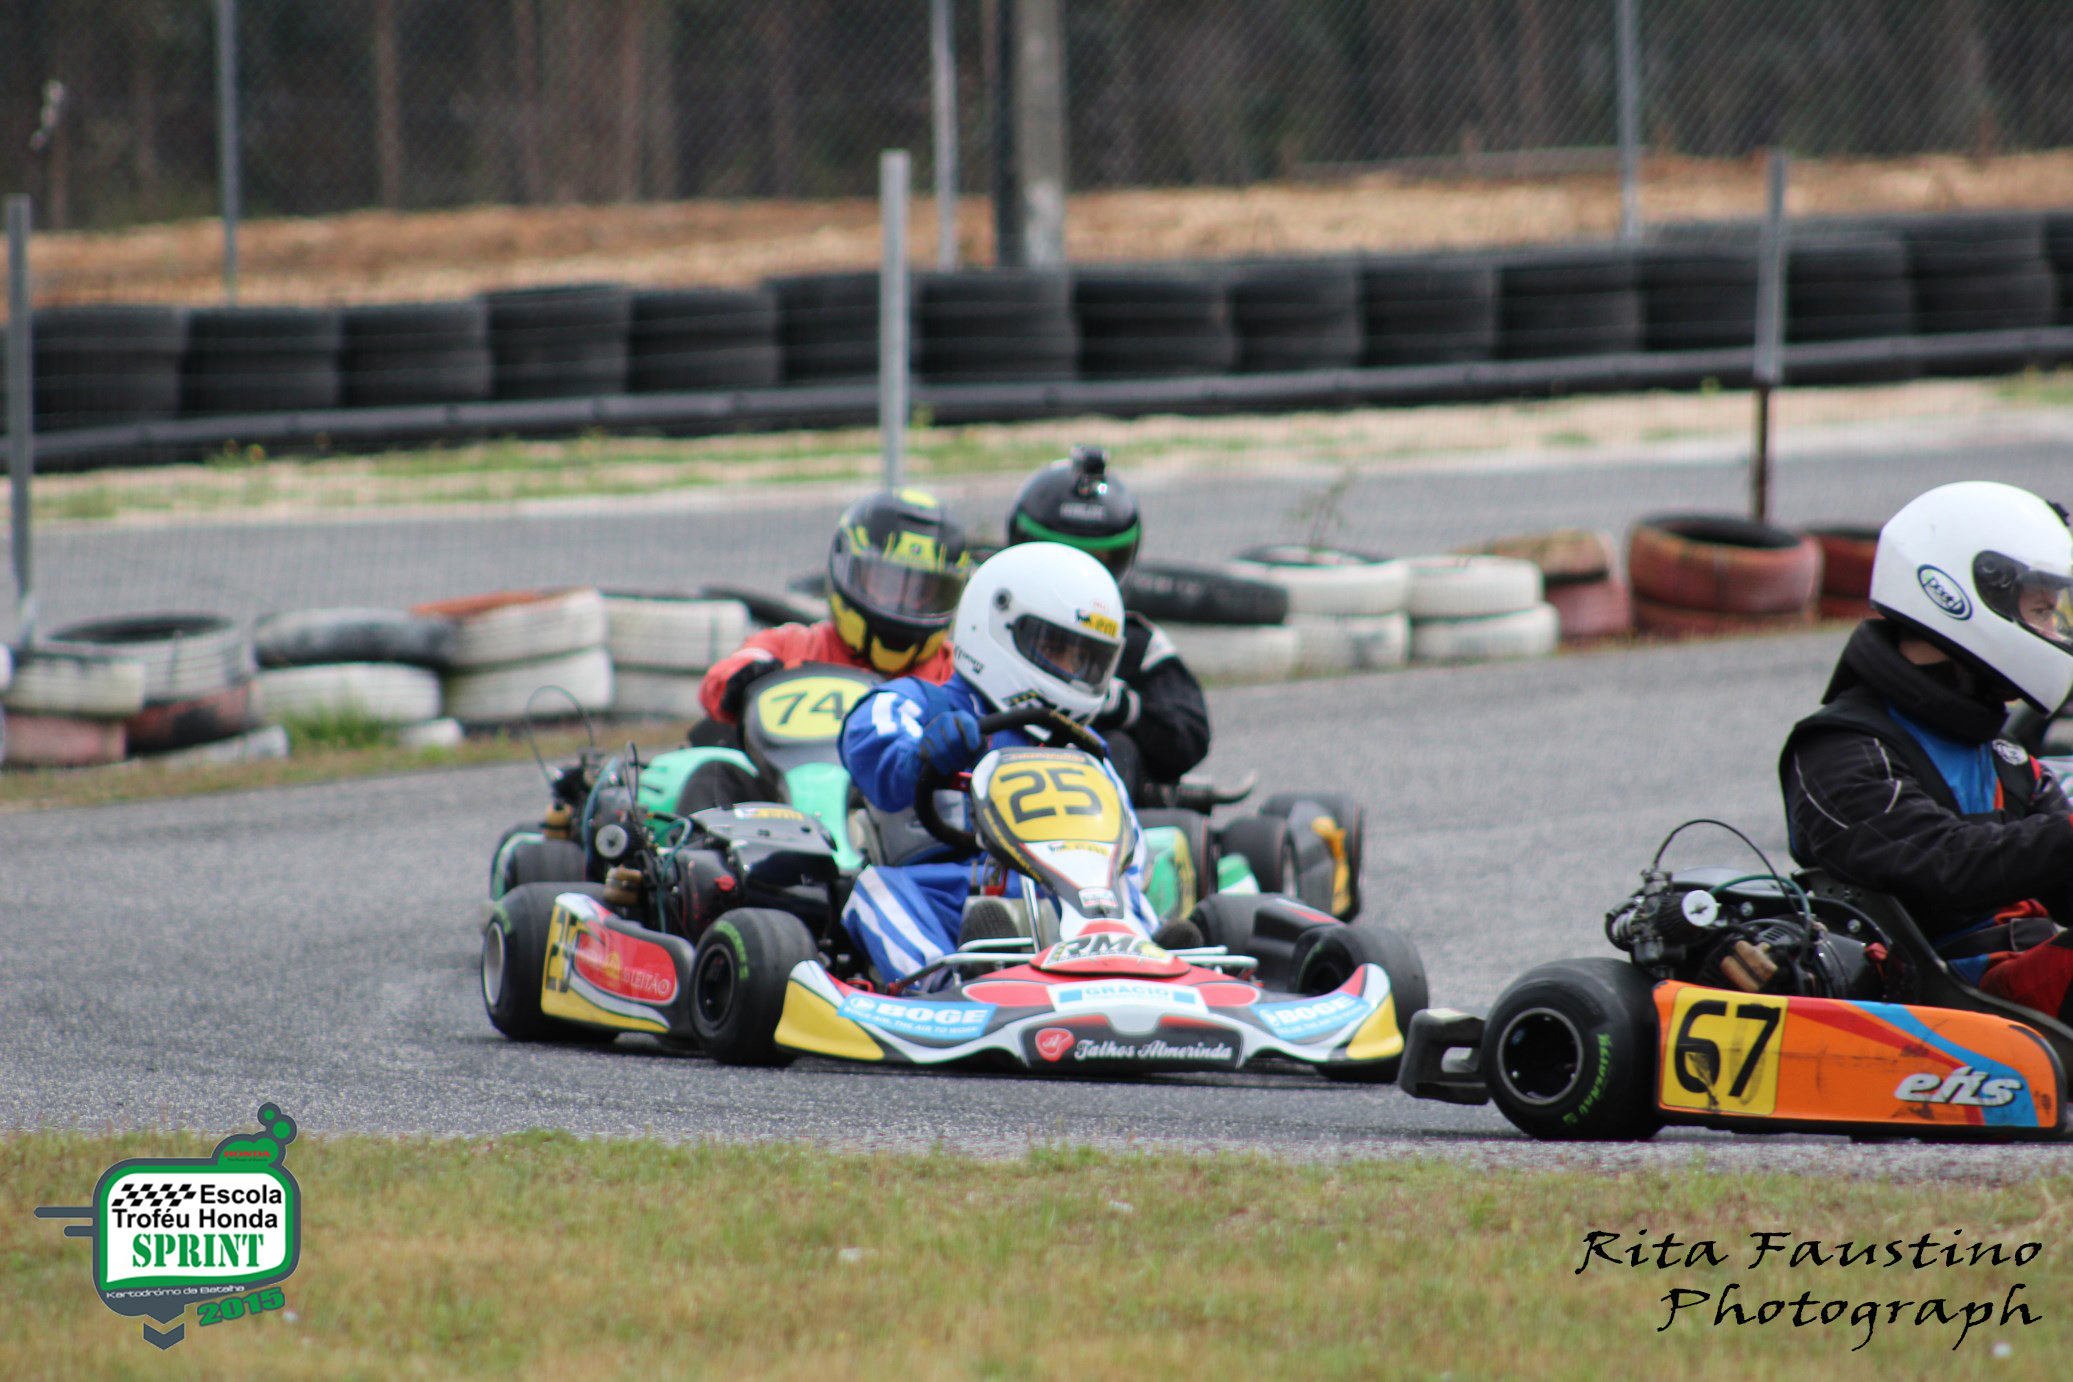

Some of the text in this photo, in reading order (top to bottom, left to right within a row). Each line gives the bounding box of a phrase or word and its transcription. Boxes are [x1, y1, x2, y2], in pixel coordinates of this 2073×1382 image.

[770, 690, 843, 726] 74
[999, 768, 1102, 824] 25
[876, 1003, 988, 1025] BOGE
[1275, 996, 1357, 1025] BOGE
[1074, 1039, 1232, 1061] Talhos Almerinda
[1674, 999, 1781, 1098] 67
